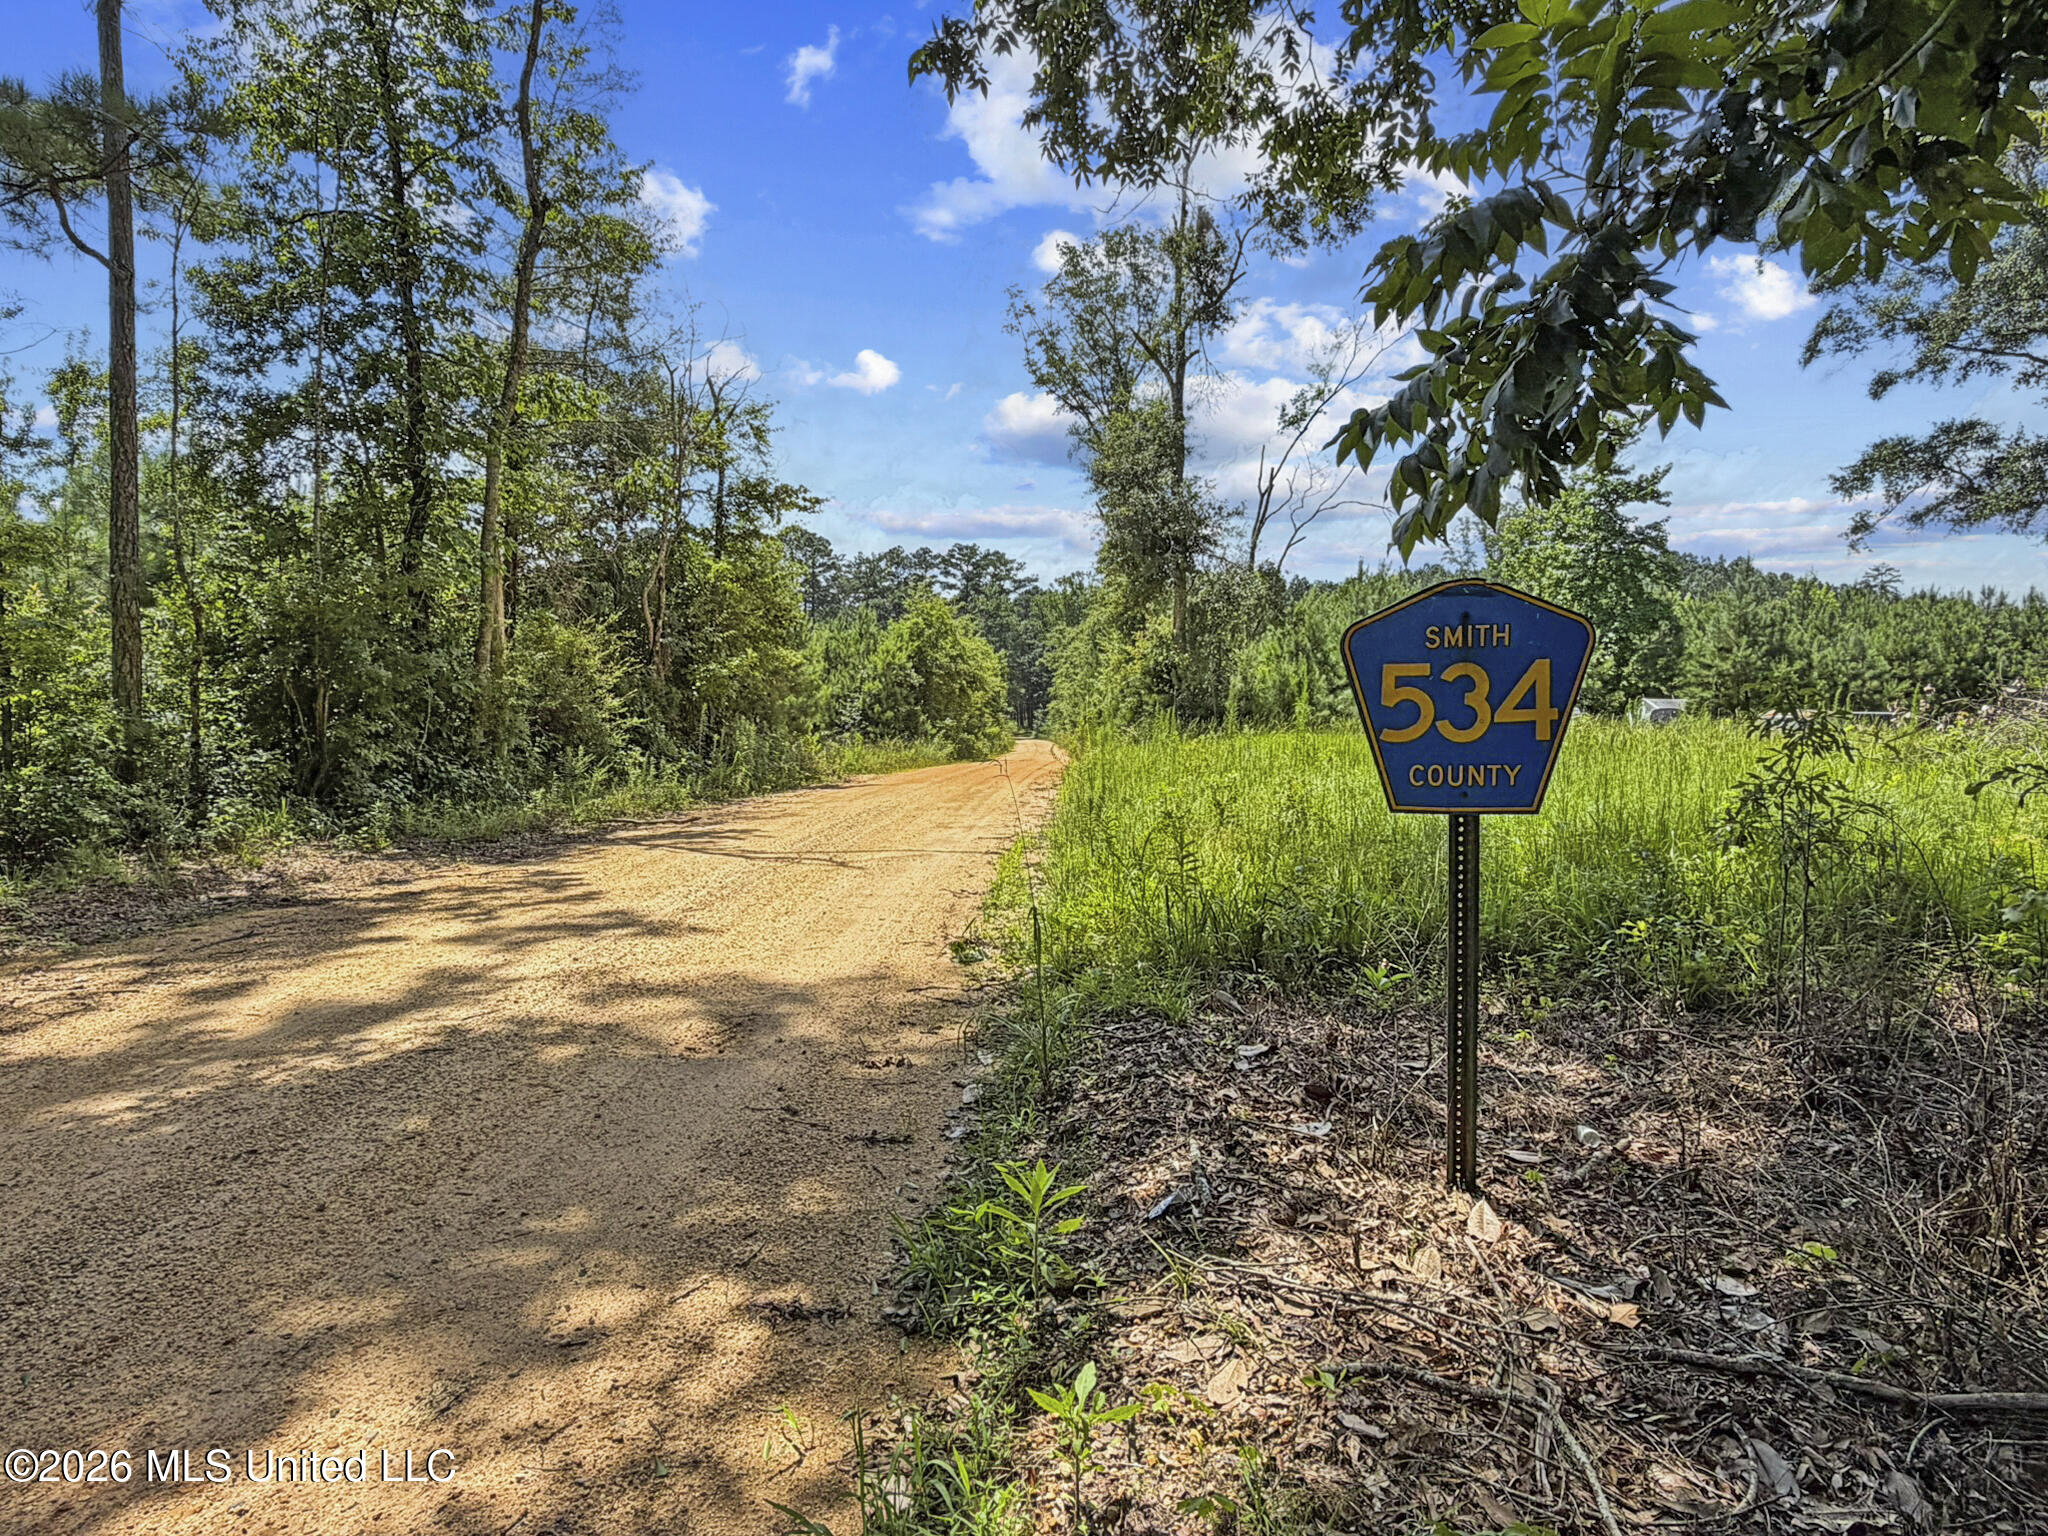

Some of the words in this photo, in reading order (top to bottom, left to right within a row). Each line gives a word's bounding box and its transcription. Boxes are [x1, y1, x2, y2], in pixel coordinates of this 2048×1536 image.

[1425, 624, 1511, 649] SMITH
[1379, 658, 1559, 743] 534
[1409, 764, 1522, 788] COUNTY
